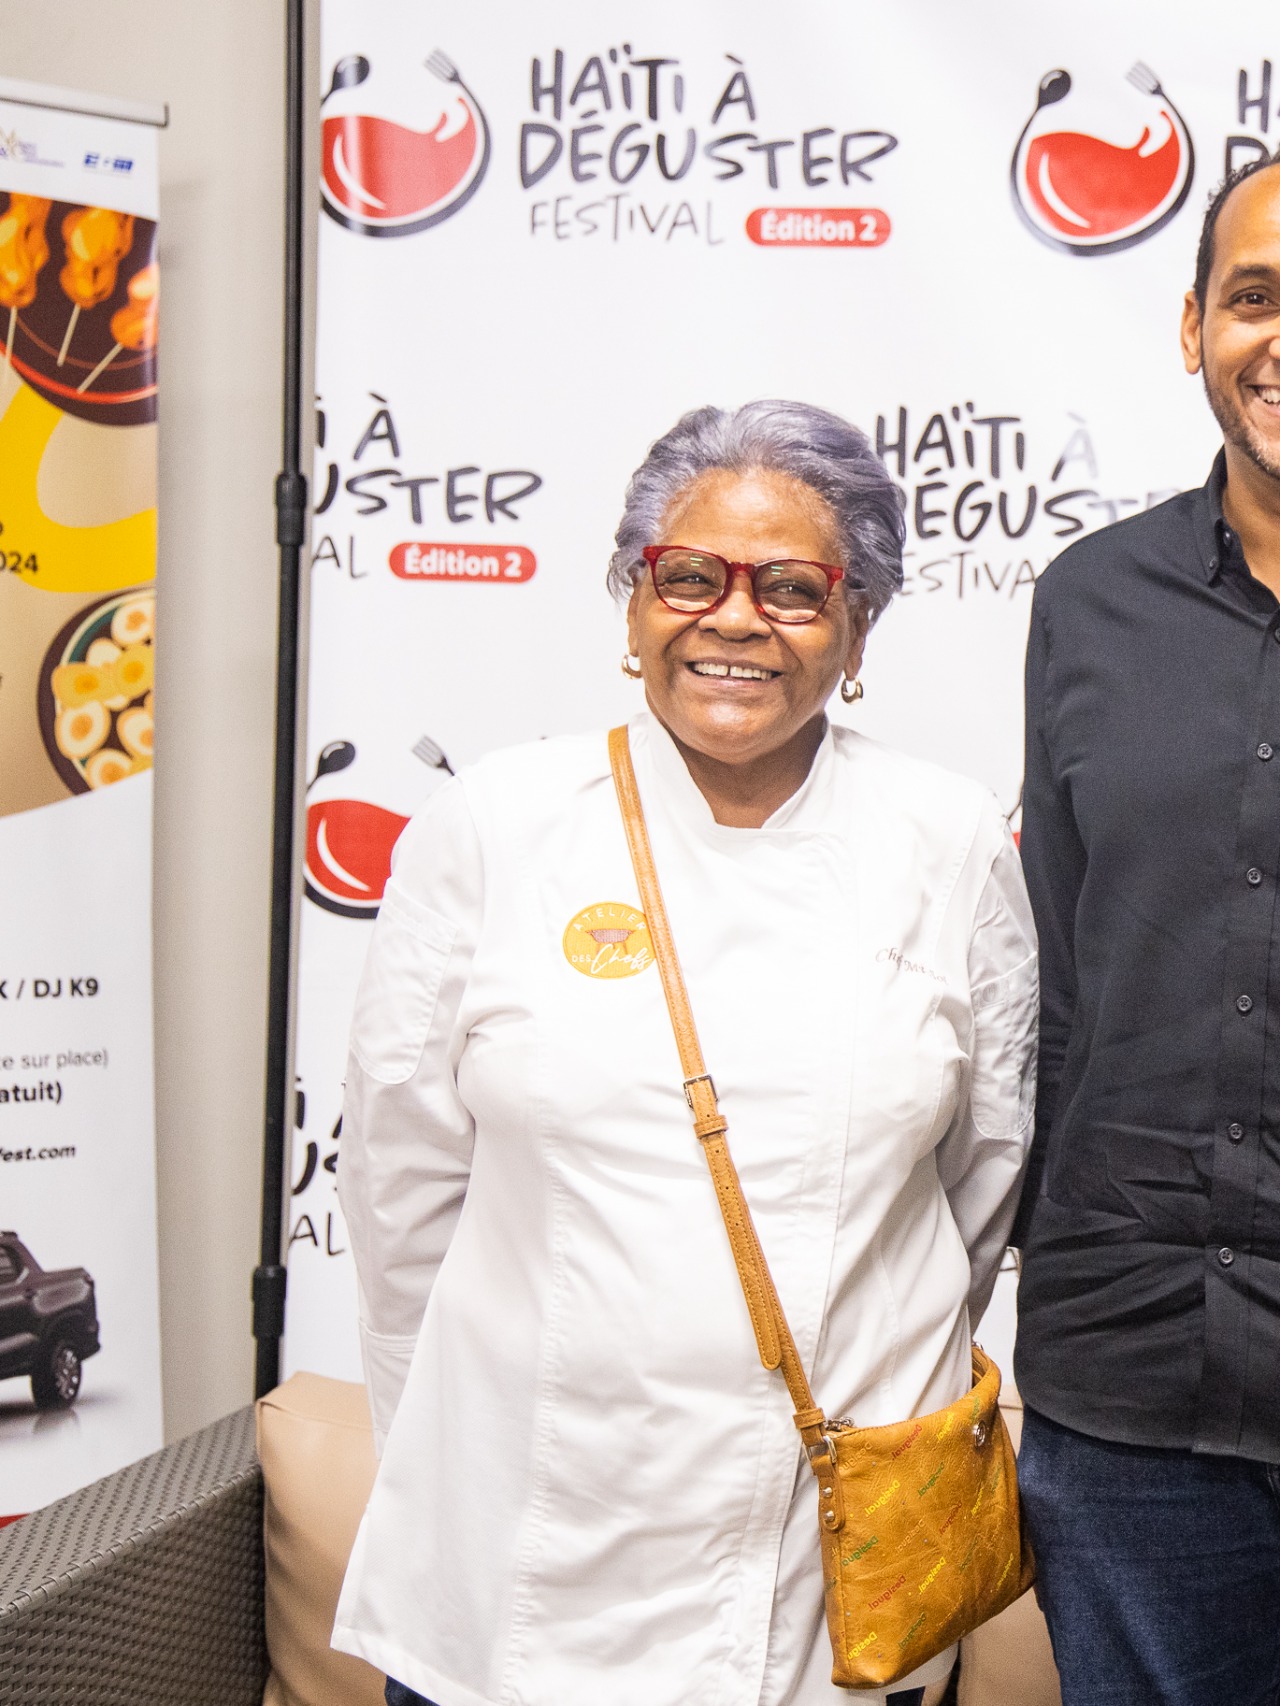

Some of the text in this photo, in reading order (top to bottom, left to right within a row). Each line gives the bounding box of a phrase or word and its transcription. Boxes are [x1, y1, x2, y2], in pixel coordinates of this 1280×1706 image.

[532, 44, 756, 125] HAÏTI À
[519, 110, 899, 190] DÉGUSTER
[530, 191, 724, 247] FESTIVAL
[760, 211, 878, 242] Édition 2
[353, 391, 401, 461] À
[1051, 411, 1098, 482] À
[404, 543, 522, 578] Édition 2
[573, 906, 647, 932] ATELIER
[571, 943, 653, 975] DES Chefs
[34, 978, 62, 998] DJ
[70, 977, 99, 998] K9
[21, 1054, 50, 1070] sur
[56, 1048, 109, 1071] place)
